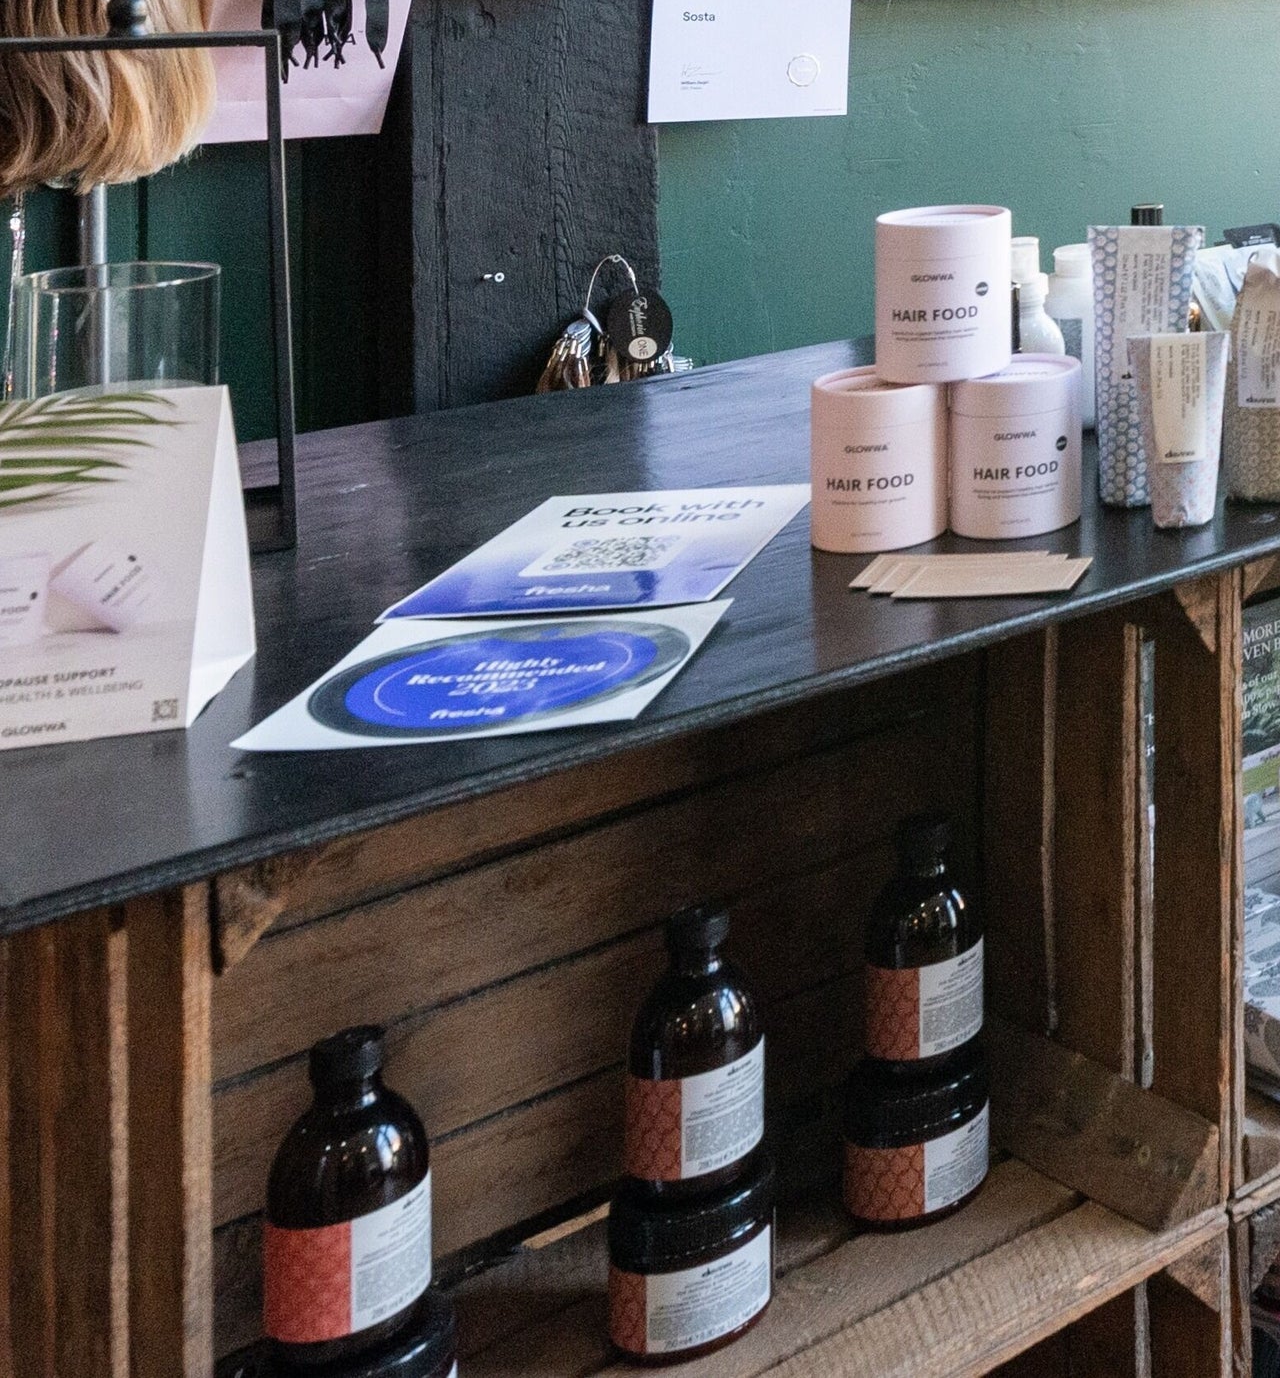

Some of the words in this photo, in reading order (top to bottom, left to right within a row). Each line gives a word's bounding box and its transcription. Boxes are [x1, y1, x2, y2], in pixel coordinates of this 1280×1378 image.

[682, 11, 716, 23] Sosta
[892, 308, 928, 322] HAIR
[932, 305, 978, 321] FOOD
[638, 340, 648, 356] ONE
[993, 431, 1037, 441] GLOWWA
[844, 444, 888, 454] GLOWWA
[973, 467, 1010, 481] HAIR
[1015, 460, 1059, 479] FOOD
[826, 477, 862, 492] HAIR
[867, 473, 914, 490] FOOD
[563, 503, 665, 517] Book
[680, 499, 766, 511] with
[562, 519, 608, 528] us
[616, 511, 742, 528] online
[525, 583, 611, 597] fresha
[473, 656, 564, 672] Highly
[53, 667, 116, 683] SUPPORT
[406, 661, 607, 685] Recommended
[69, 679, 143, 697] WELLBEING
[447, 678, 539, 697] 2023
[429, 706, 506, 720] fresha
